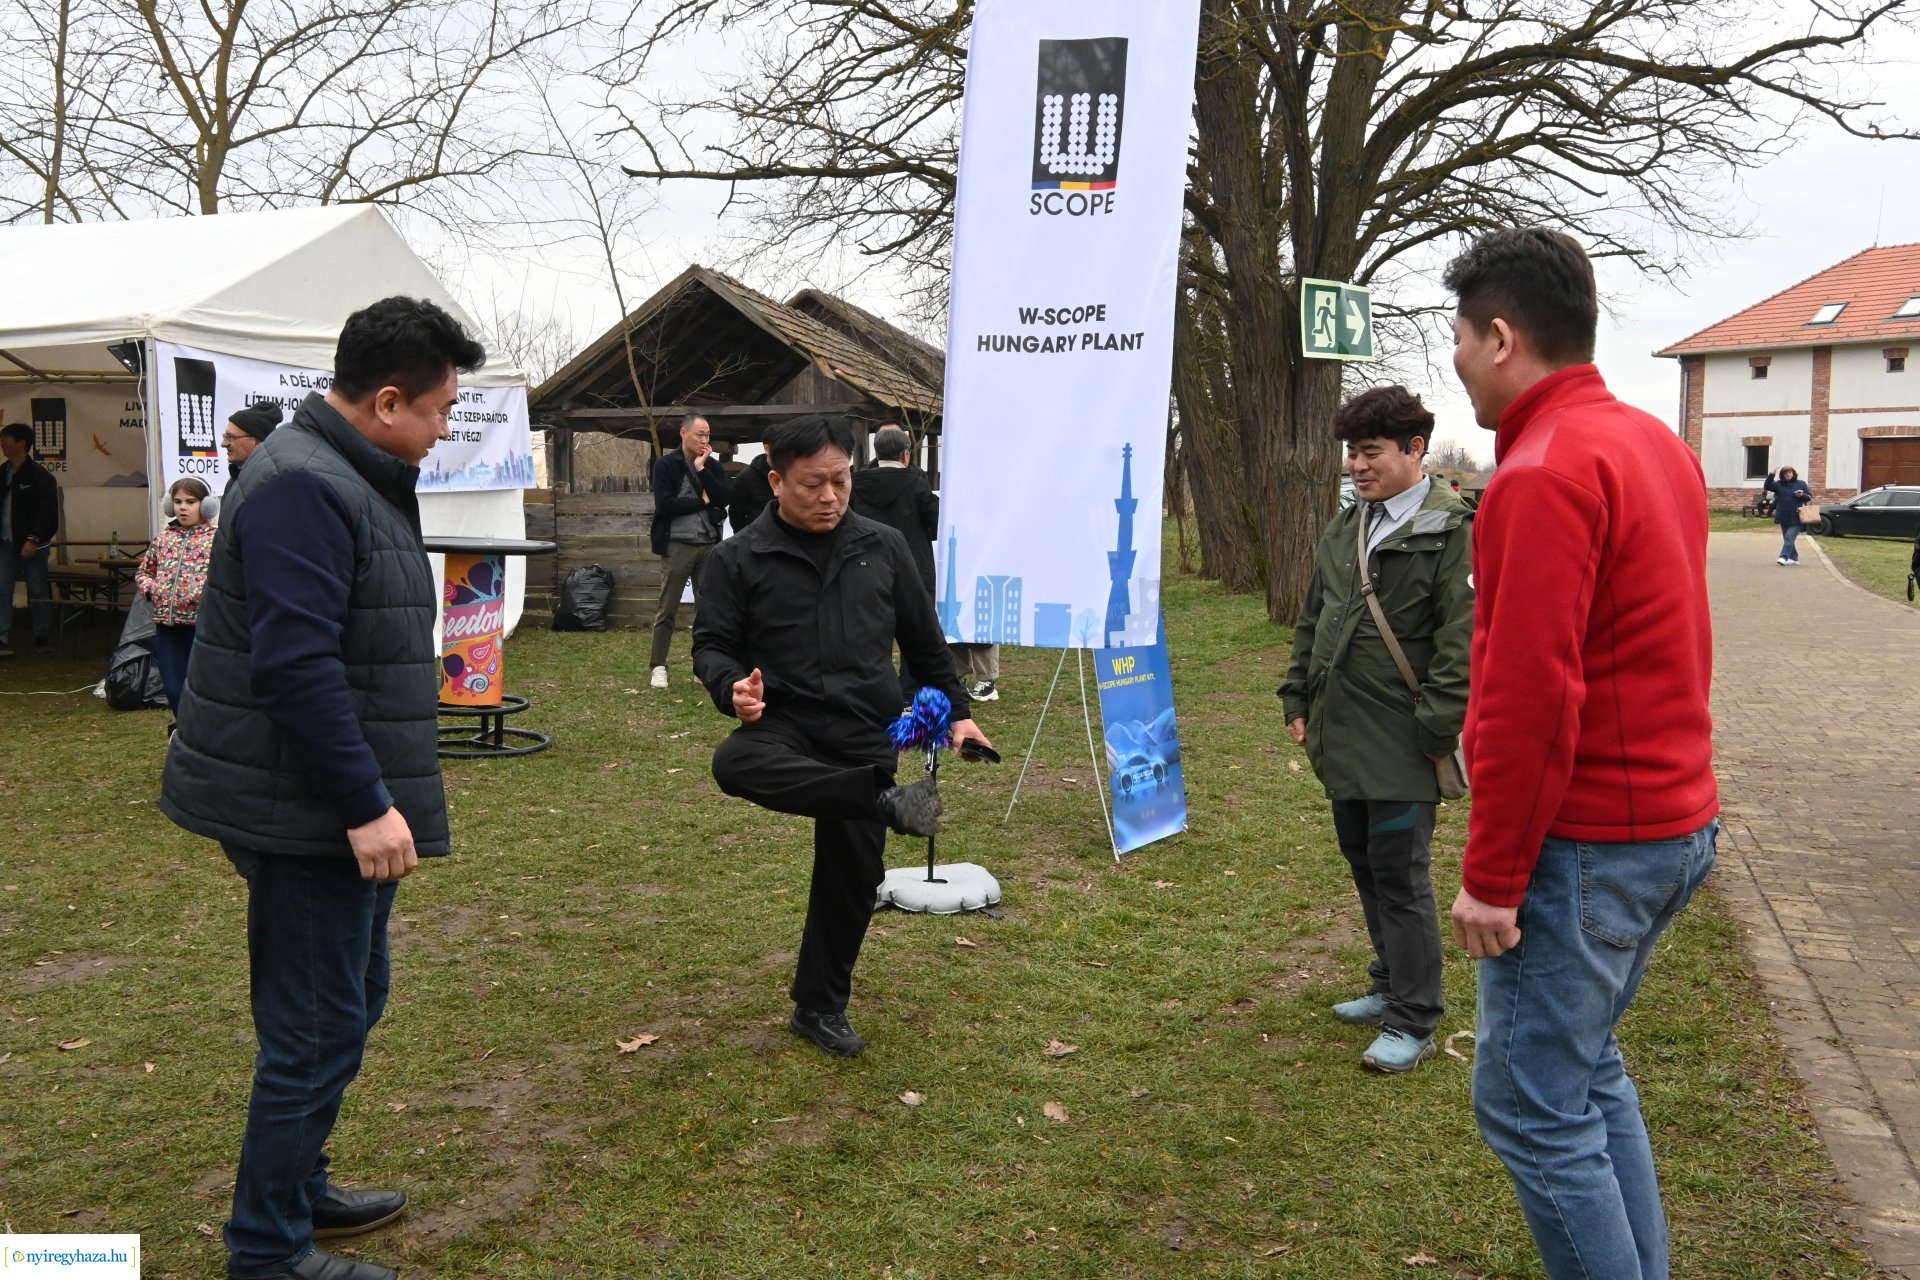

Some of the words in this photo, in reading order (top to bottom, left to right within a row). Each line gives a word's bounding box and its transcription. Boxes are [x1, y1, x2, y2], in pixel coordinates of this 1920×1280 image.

[1030, 191, 1115, 216] SCOPE
[1018, 304, 1106, 325] W-SCOPE
[977, 334, 1077, 353] HUNGARY
[1081, 332, 1144, 351] PLANT
[279, 373, 289, 386] A
[471, 393, 486, 404] KFT.
[463, 410, 509, 424] SZEPARÁTOR
[461, 428, 482, 442] VÉGZI
[178, 458, 219, 474] SCOPE
[1111, 655, 1135, 676] WHP
